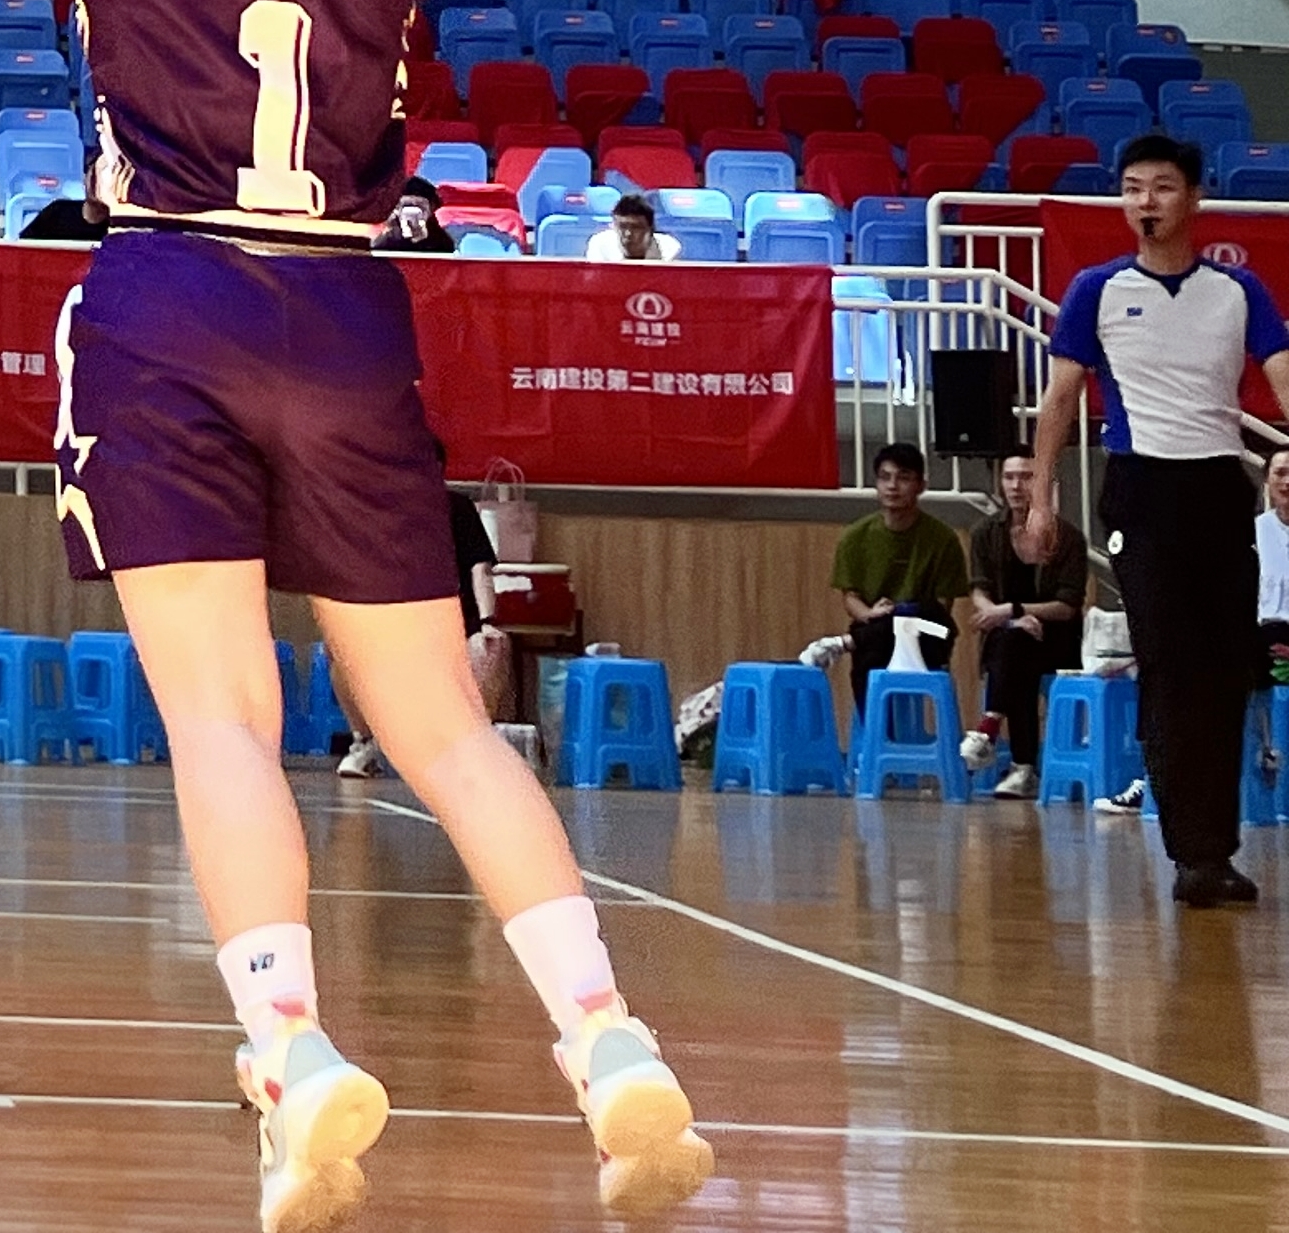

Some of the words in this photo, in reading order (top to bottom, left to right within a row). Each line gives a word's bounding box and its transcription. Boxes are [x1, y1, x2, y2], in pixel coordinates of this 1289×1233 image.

[510, 366, 794, 396] 云南建投第二建设有限公司
